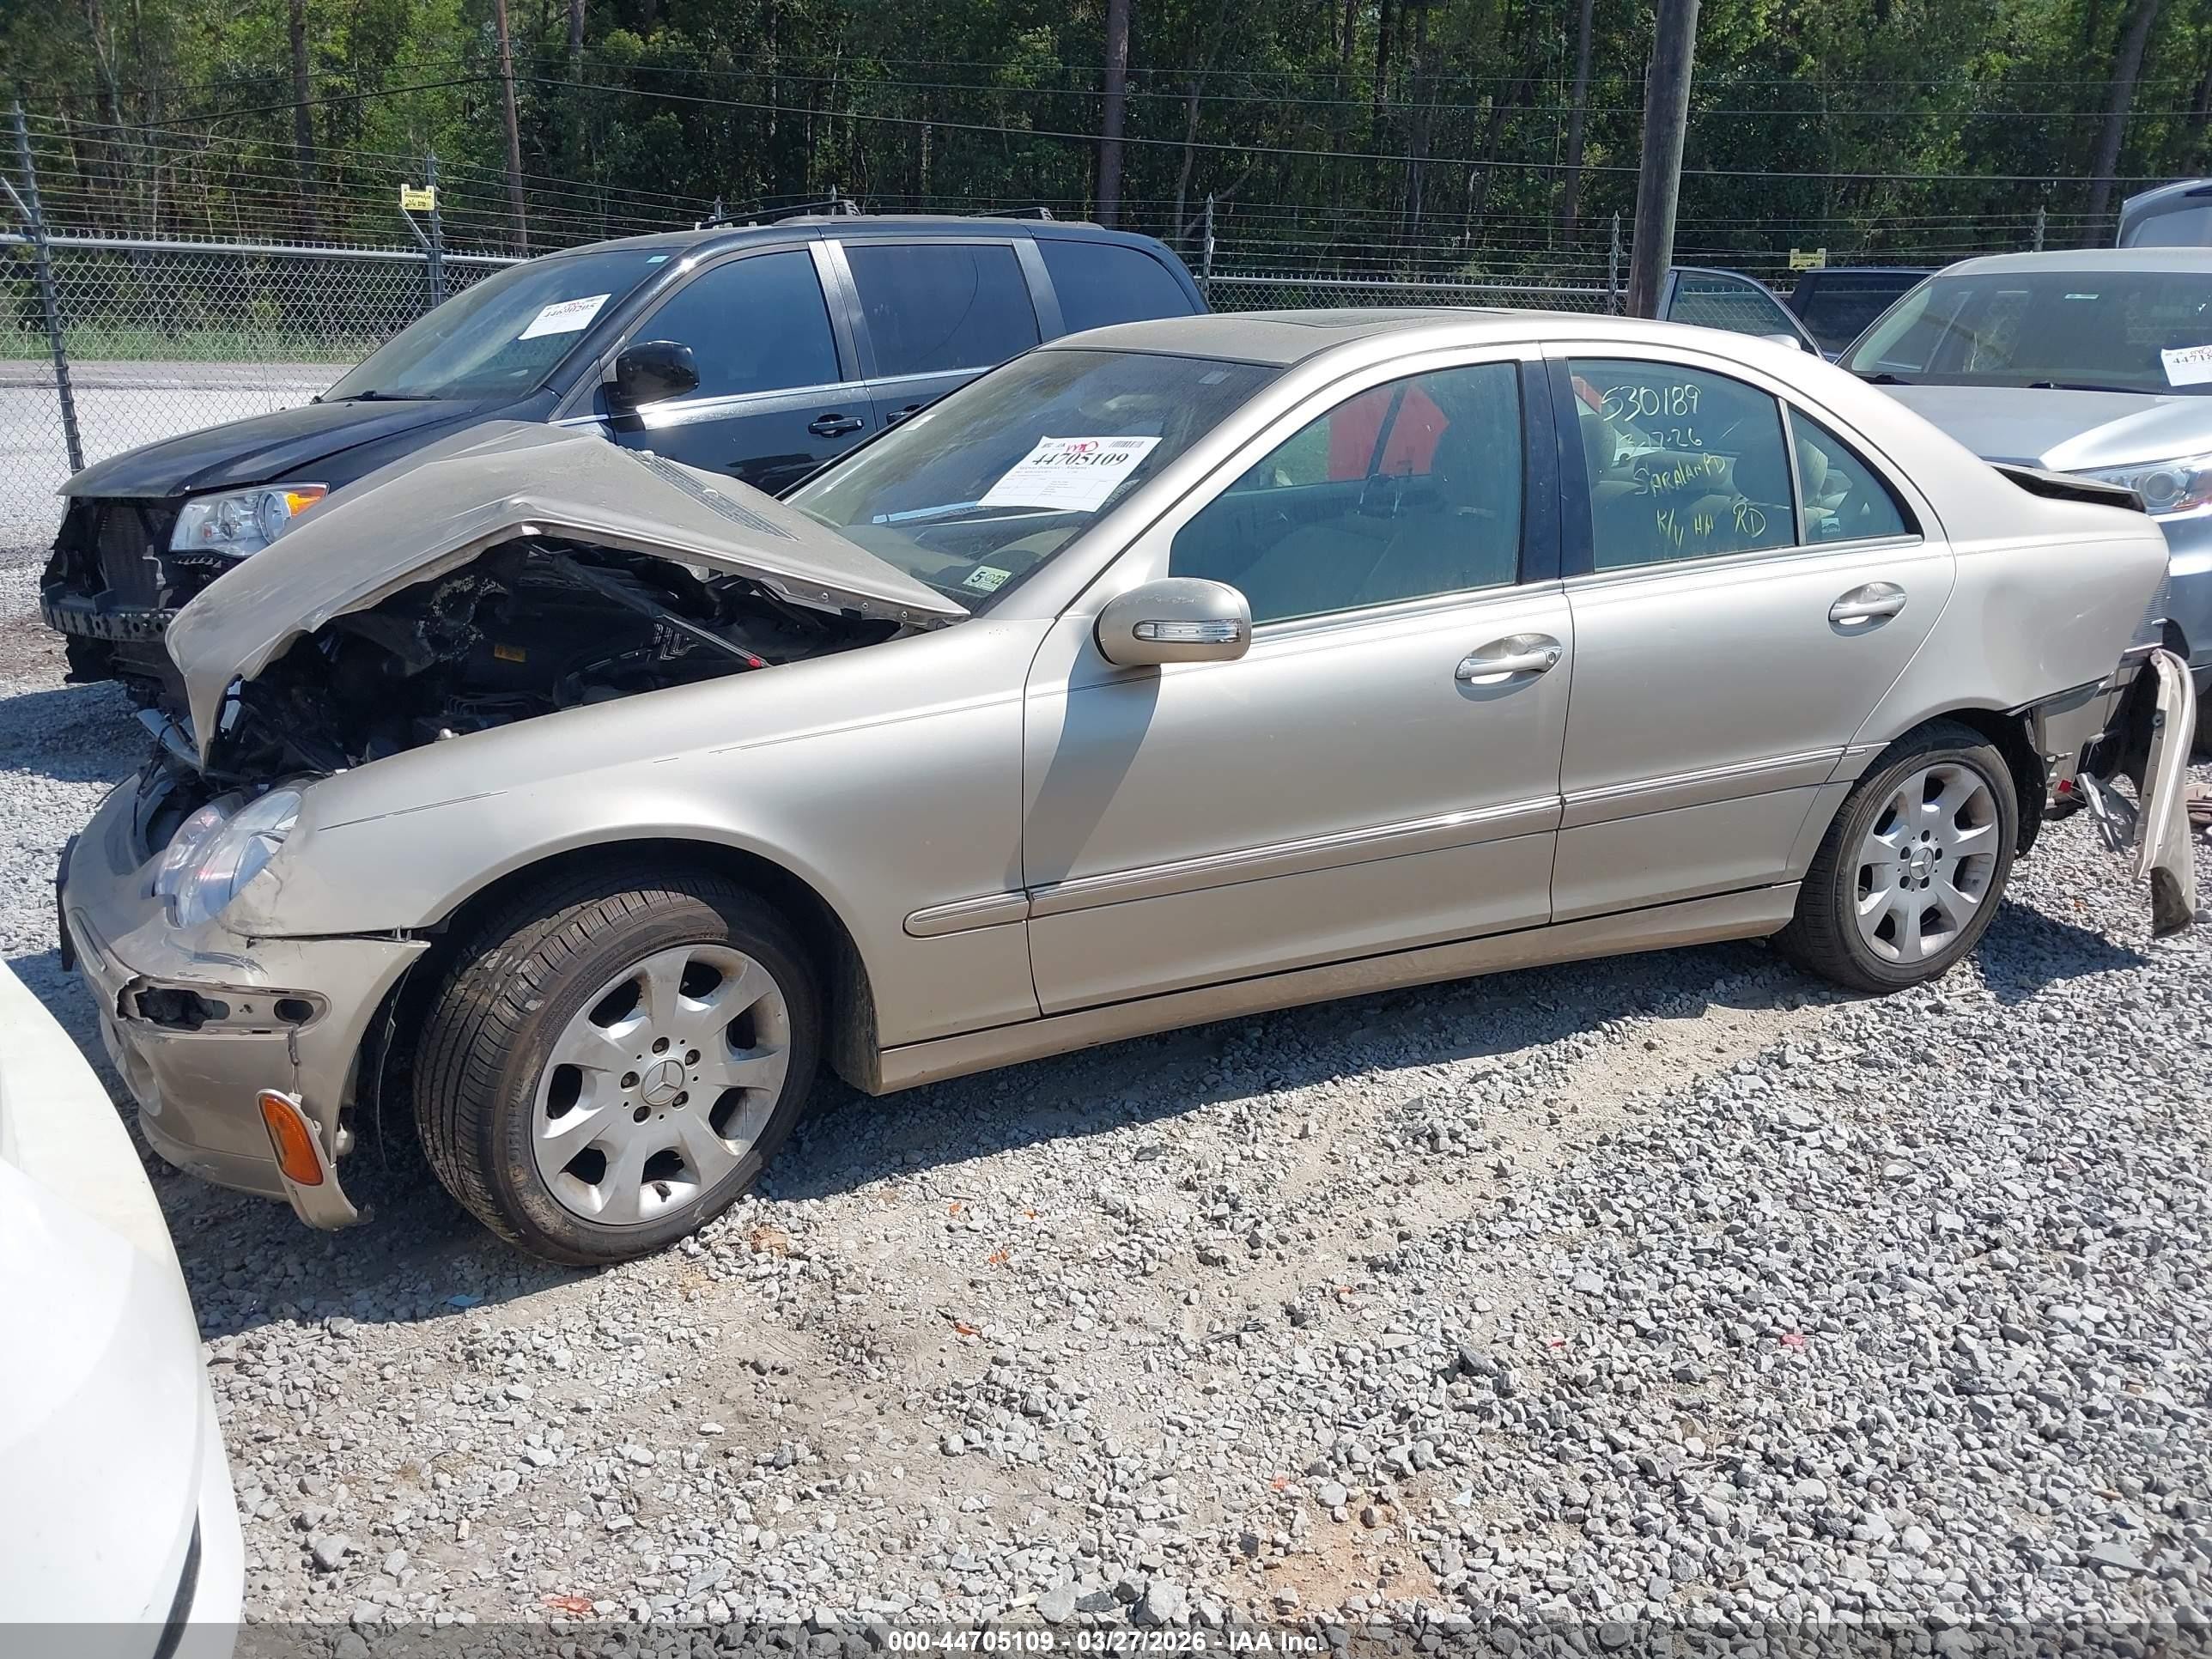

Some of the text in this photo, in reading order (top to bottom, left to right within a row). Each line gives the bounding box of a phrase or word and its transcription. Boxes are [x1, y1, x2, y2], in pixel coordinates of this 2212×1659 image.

[1601, 385, 1701, 421] 530189
[1032, 453, 1129, 466] 44705109
[971, 571, 987, 583] 5
